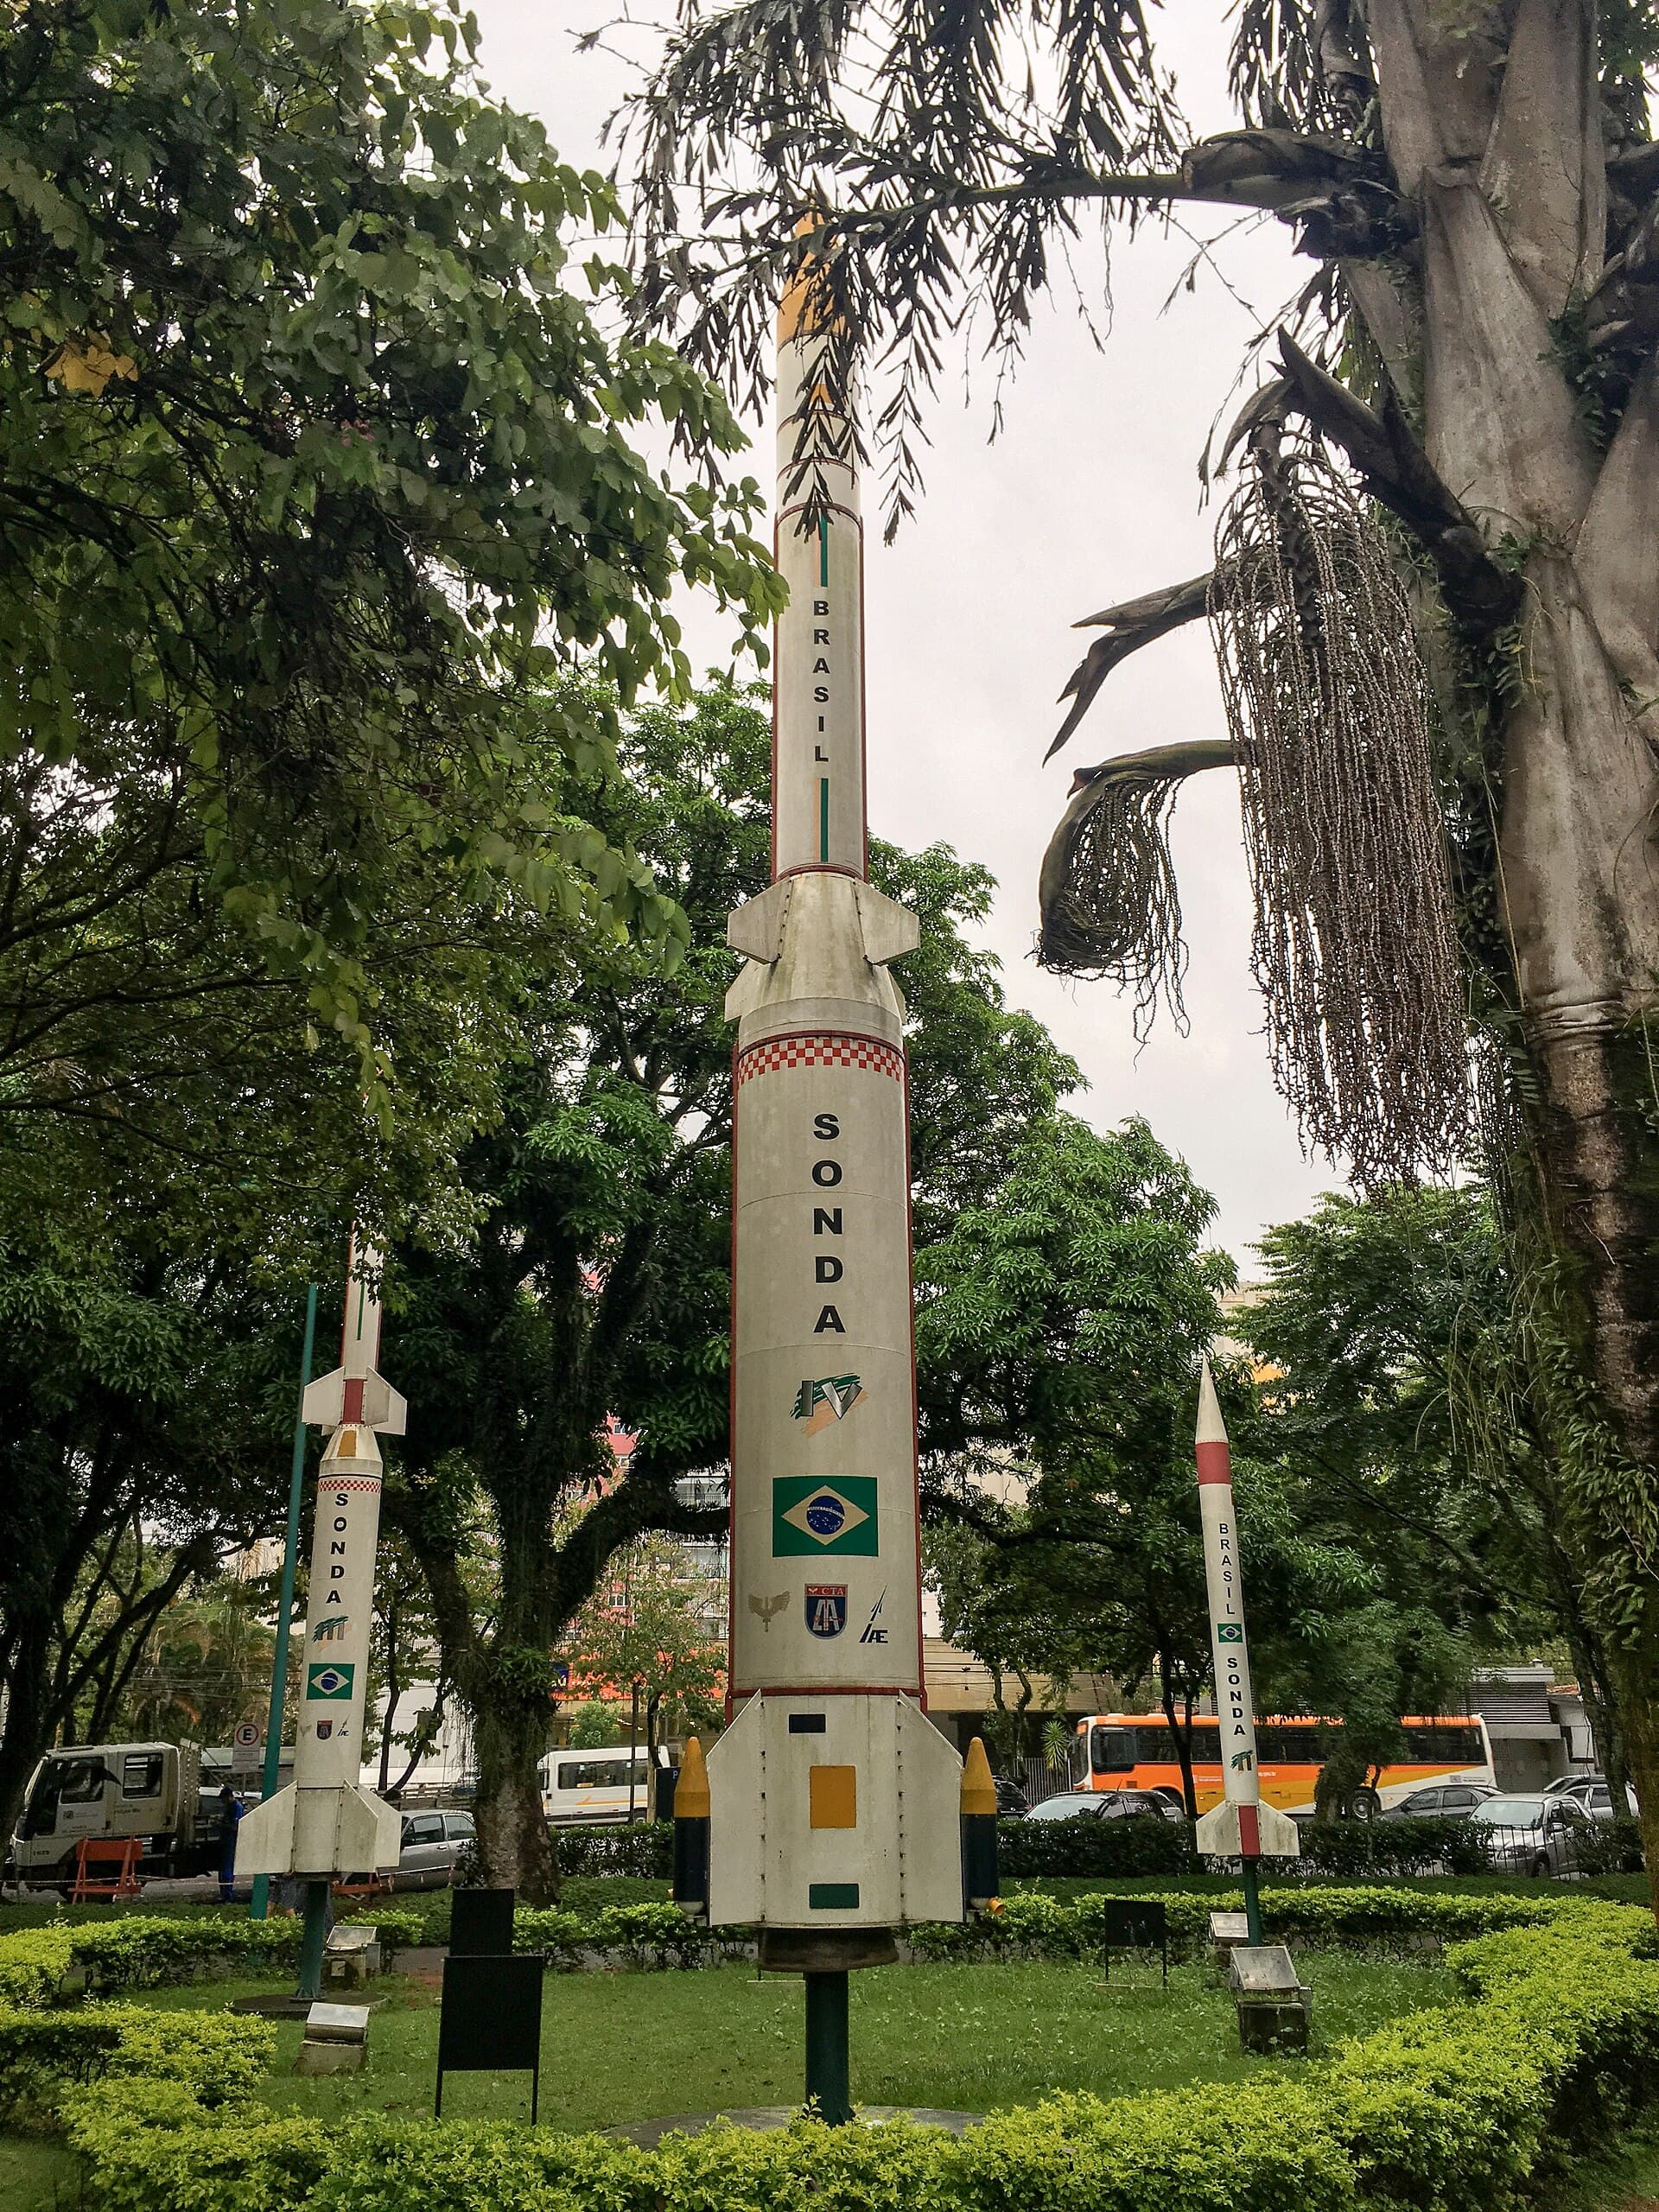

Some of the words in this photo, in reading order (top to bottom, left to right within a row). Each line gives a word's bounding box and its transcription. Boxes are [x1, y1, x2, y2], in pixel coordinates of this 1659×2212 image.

[812, 600, 830, 762] BRASIL
[811, 1113, 846, 1334] SONDA
[801, 1380, 862, 1420] IV
[326, 1492, 349, 1605] SONDA
[1219, 1523, 1236, 1615] BRASIL
[243, 1728, 252, 1741] E
[1227, 1657, 1246, 1736] SONDA
